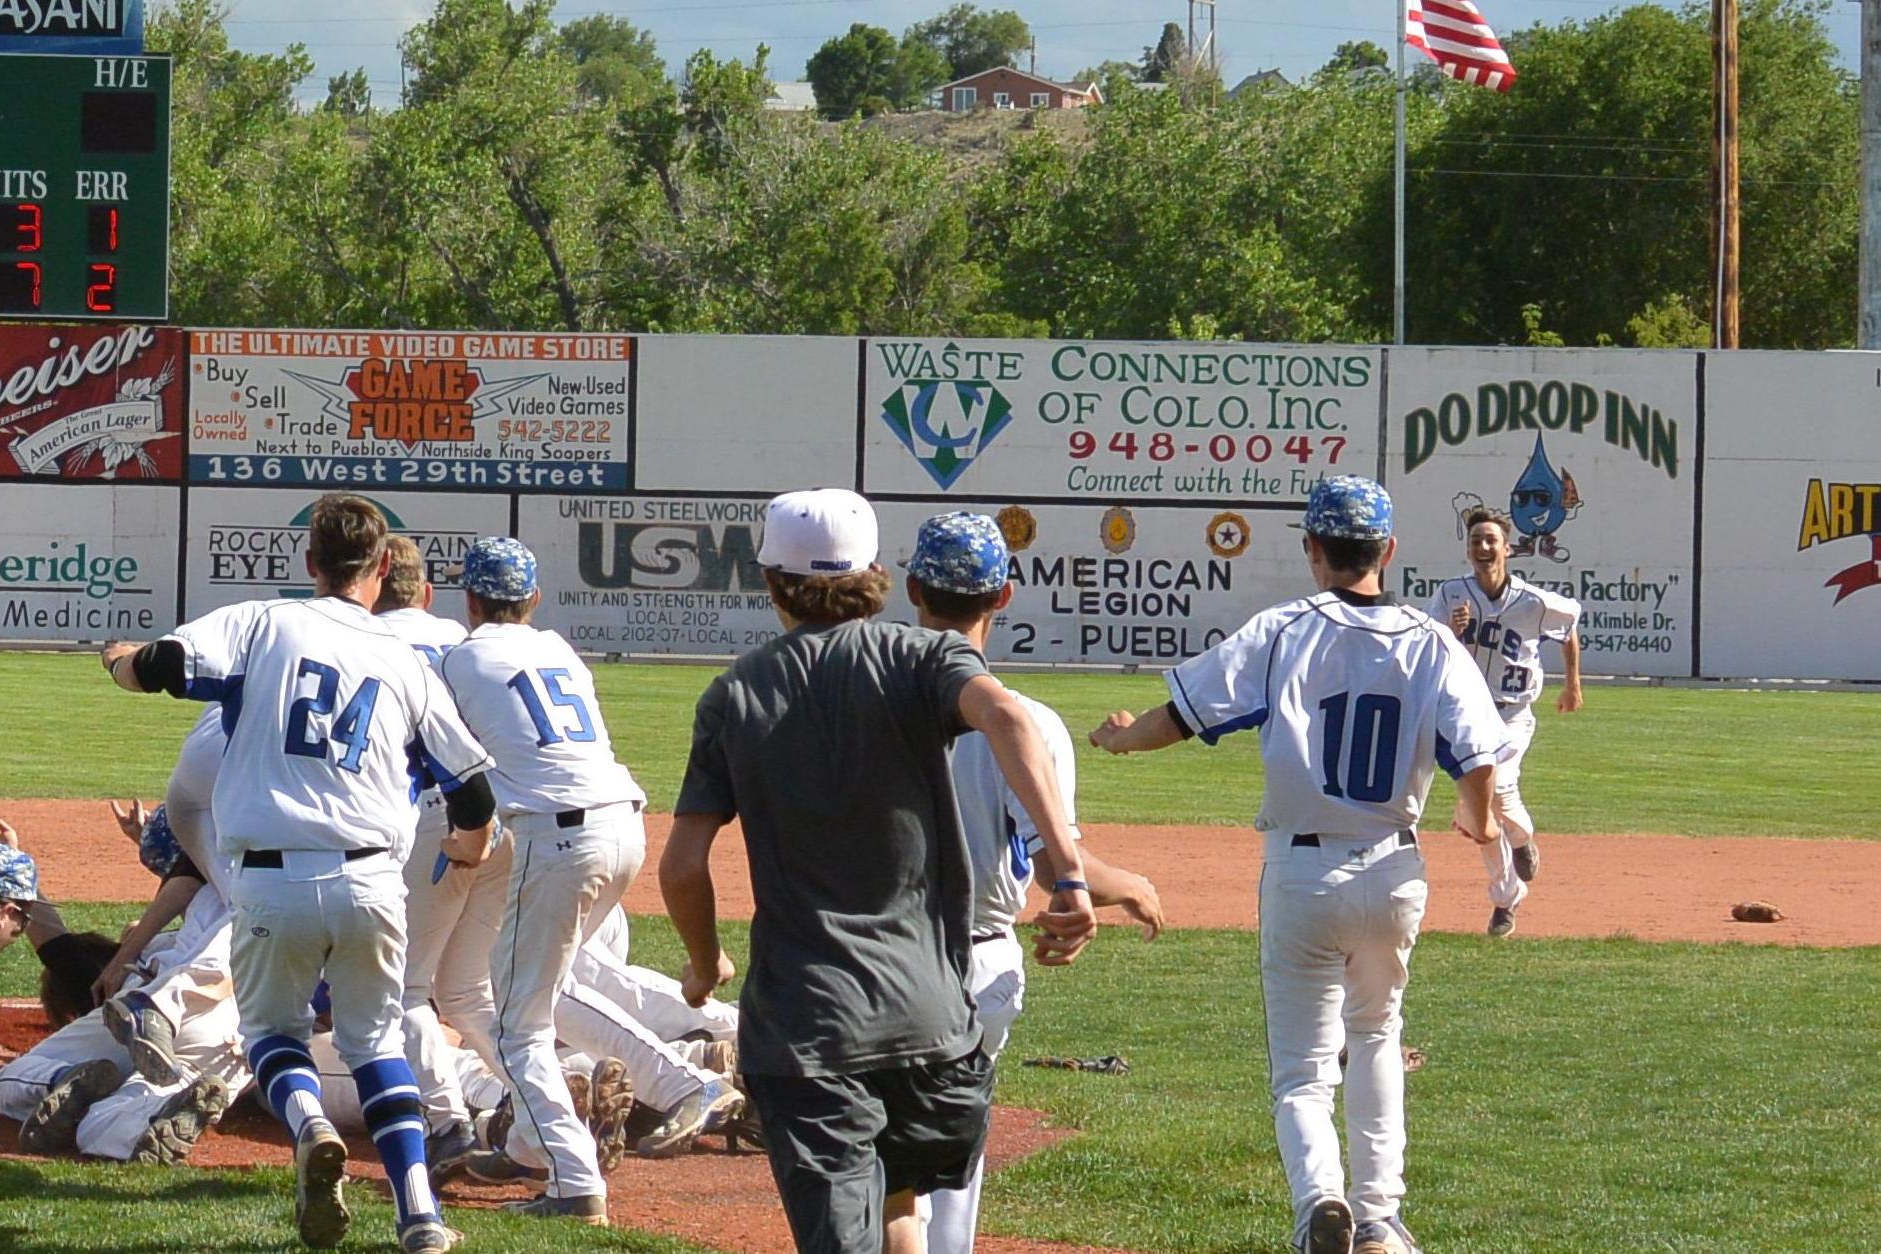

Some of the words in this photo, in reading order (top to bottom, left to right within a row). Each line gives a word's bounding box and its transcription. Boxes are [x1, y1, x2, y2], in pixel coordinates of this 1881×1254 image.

[94, 59, 148, 89] H/E
[76, 171, 129, 200] ERR
[17, 204, 41, 251] 3
[16, 262, 40, 307] 7
[87, 264, 114, 311] 2
[196, 332, 242, 355] THE
[249, 333, 370, 357] ULTIMATE
[378, 335, 454, 358] VIDEO
[462, 336, 534, 359] GAME
[543, 337, 625, 360] STORE
[207, 358, 249, 388] Buy
[360, 358, 468, 400] GAME
[876, 342, 1024, 380] WASTE
[1051, 345, 1371, 387] CONNECTIONS
[245, 386, 287, 410] Sell
[507, 397, 555, 415] Video
[560, 399, 625, 416] Games
[1038, 391, 1102, 425] OF
[1120, 386, 1256, 430] COLO.
[193, 425, 247, 441] Owned
[194, 411, 247, 429] Locally
[277, 413, 338, 436] Trade
[347, 402, 474, 442] FORCE
[497, 420, 611, 443] 542-5222
[1404, 393, 1471, 474] DO
[1478, 380, 1598, 437] DROP
[1605, 391, 1678, 478] INN
[28, 419, 101, 464] American
[105, 412, 152, 431] Lager
[256, 439, 298, 455] Next
[305, 441, 322, 456] to
[331, 440, 398, 457] Pueblo's
[421, 443, 492, 459] Northside
[499, 443, 534, 464] King
[541, 443, 612, 463] Soopers
[1069, 430, 1347, 464] 948-0047
[208, 456, 282, 480] 136
[302, 458, 387, 482] West
[400, 459, 488, 484] 29th
[496, 461, 605, 487] Street
[1067, 465, 1163, 493] Connect
[1175, 466, 1231, 493] with
[1242, 468, 1280, 494] the
[559, 499, 634, 519] UNITED
[644, 501, 766, 523] STEELWORK
[209, 530, 303, 554] ROCKY
[578, 521, 770, 590] USW
[210, 553, 290, 580] EYE
[1007, 555, 1231, 591] AMERICAN
[559, 591, 597, 606] UNITY
[601, 592, 629, 607] AND
[634, 592, 715, 608] STRENGTH
[719, 593, 742, 609] FOR
[1051, 591, 1190, 617] LEGION
[3, 600, 154, 630] Medicine
[627, 610, 675, 625] LOCAL
[682, 612, 719, 627] 2102
[1593, 611, 1648, 631] Kimble
[1653, 613, 1675, 631] Dr.
[570, 626, 615, 641] LOCAL
[688, 629, 737, 645] LOCAL
[1579, 634, 1671, 653] 9-547-8440
[1501, 664, 1527, 693] 23
[285, 657, 380, 774] 24
[507, 667, 597, 748] 15
[1319, 691, 1401, 803] 10
